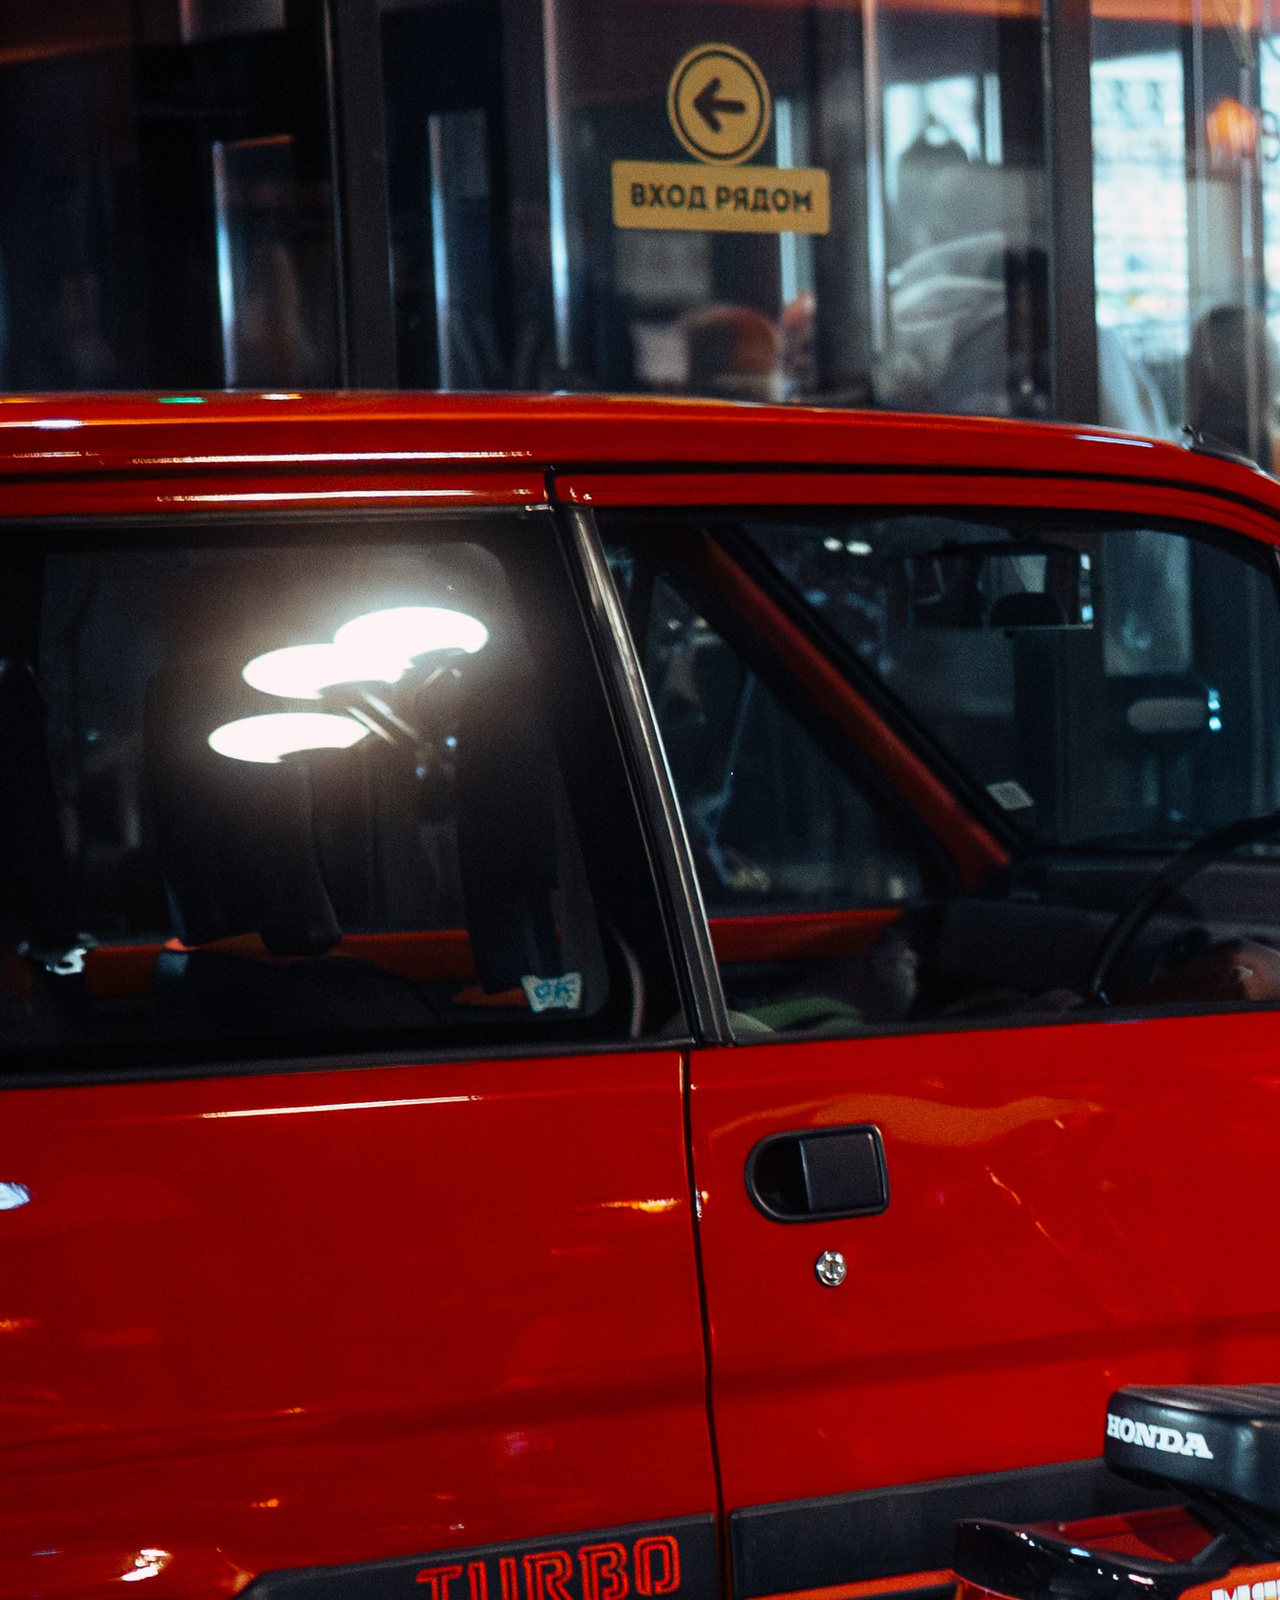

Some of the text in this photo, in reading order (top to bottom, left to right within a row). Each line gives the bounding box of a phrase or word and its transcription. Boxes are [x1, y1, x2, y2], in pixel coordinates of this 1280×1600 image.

[630, 182, 812, 213] ВХОД РЯДОМ
[1106, 1413, 1214, 1460] HONDA
